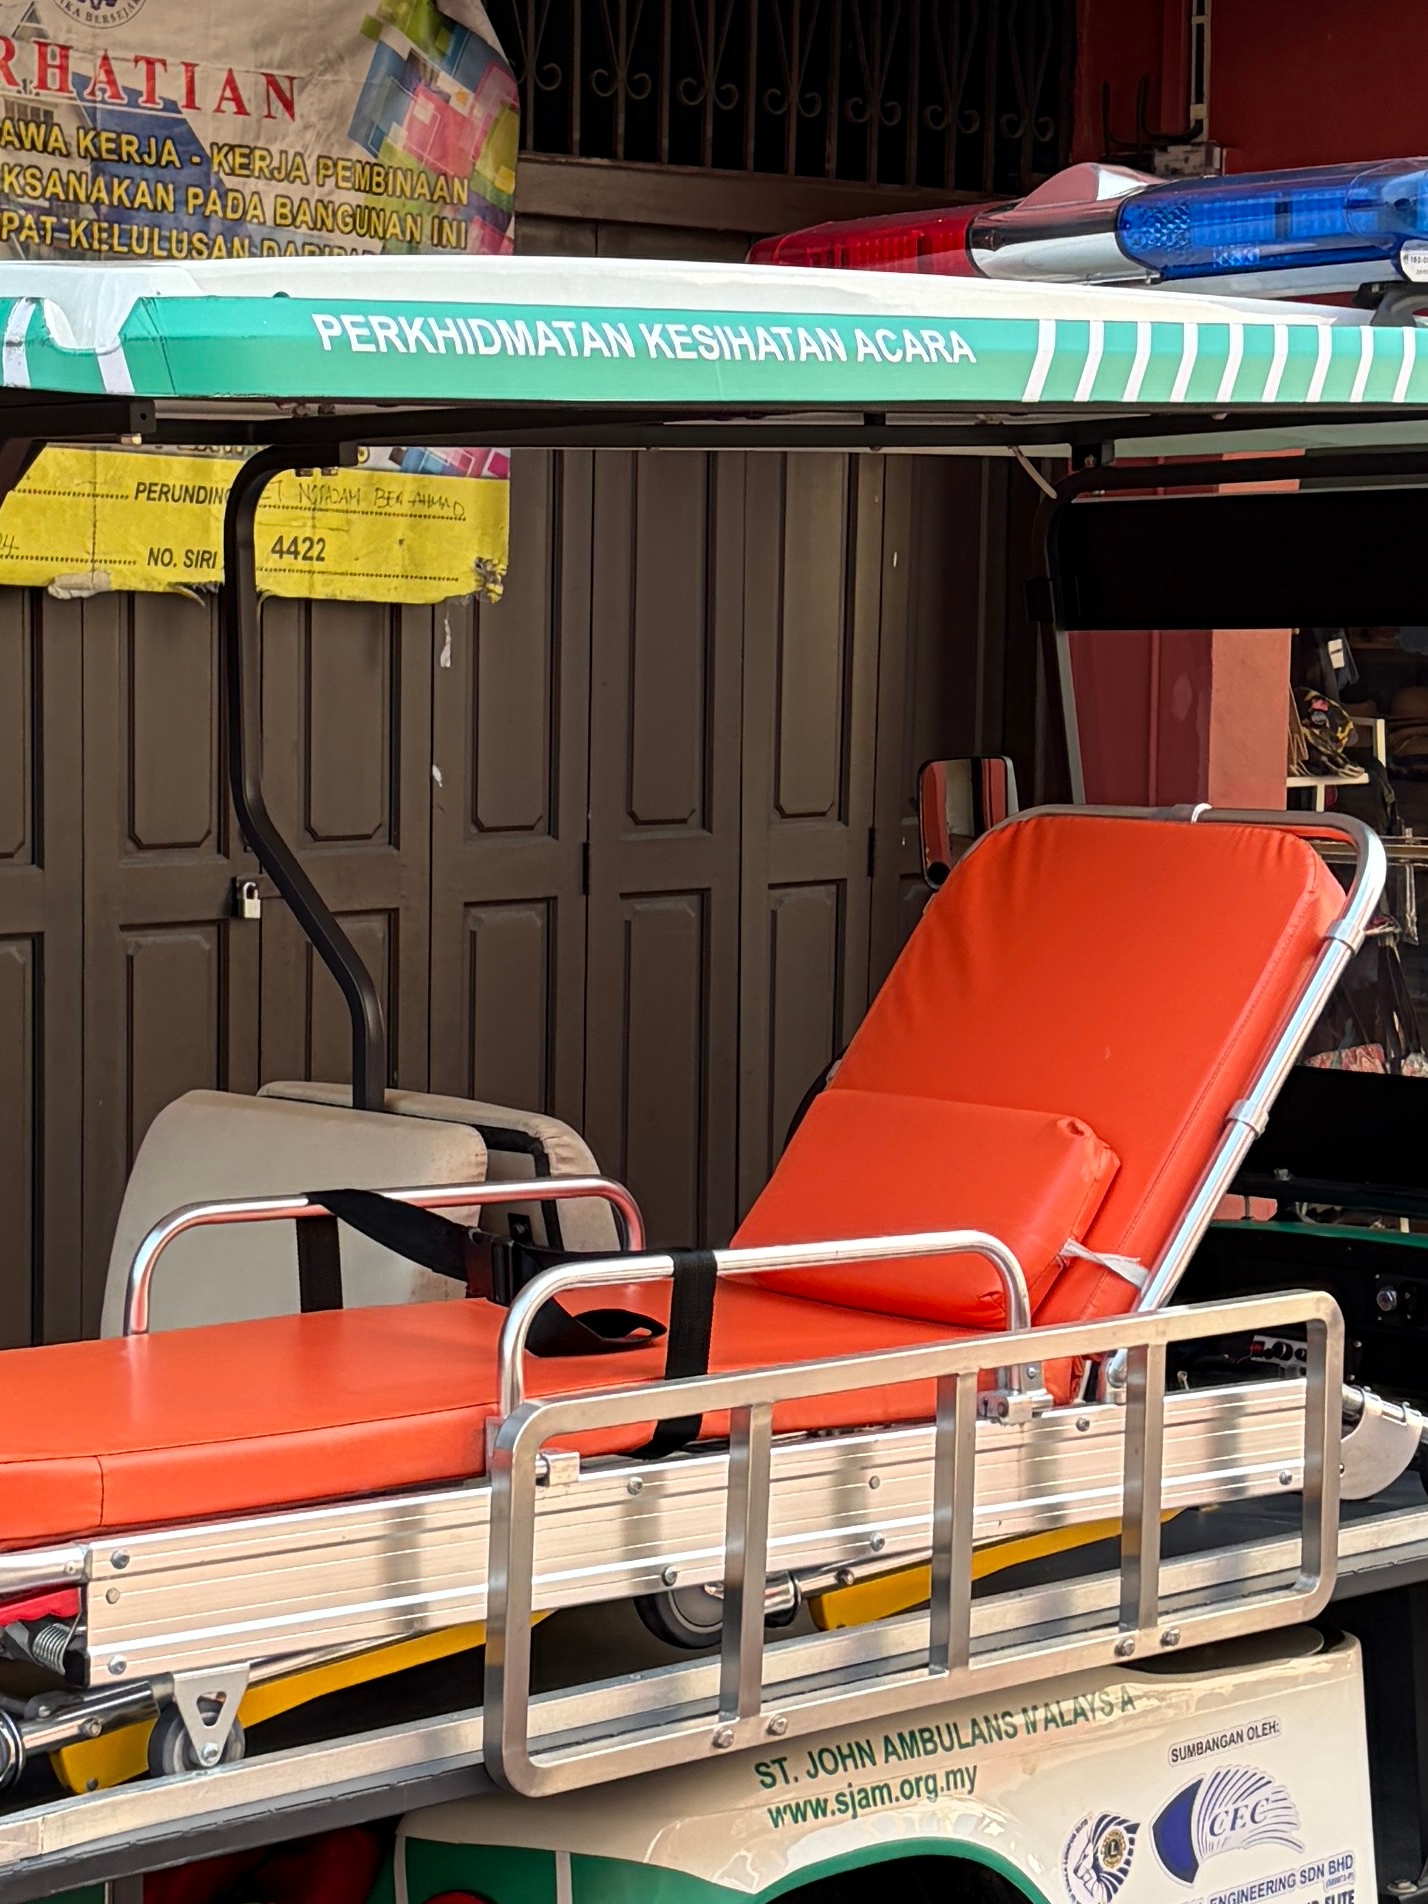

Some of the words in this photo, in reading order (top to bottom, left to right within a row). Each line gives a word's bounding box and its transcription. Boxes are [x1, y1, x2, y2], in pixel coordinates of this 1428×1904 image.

[78, 127, 181, 169] KERJA
[210, 142, 309, 185] KERJA
[317, 155, 469, 207] PEMBINAAN
[70, 217, 250, 259] KELULUSAN
[187, 185, 266, 225] PADA
[274, 195, 422, 243] BANGUNAN
[431, 216, 469, 250] INI
[311, 313, 638, 359] PERKHIDMATAN
[640, 321, 849, 363] KESIHATAN
[853, 328, 979, 366] ACARA
[146, 547, 178, 569] NO.
[182, 548, 219, 570] SIRI
[270, 535, 327, 563] 4422
[754, 1756, 799, 1790] ST.
[805, 1739, 877, 1780] JOHN
[883, 1709, 1019, 1764] AMBULANS
[1171, 1728, 1244, 1763] SUMBANGAN
[1246, 1720, 1281, 1741] OLEH:
[767, 1764, 980, 1830] www.sjam.org.my
[1209, 1797, 1270, 1838] CEC
[1299, 1863, 1325, 1885] SDN
[1328, 1854, 1354, 1876] BHD
